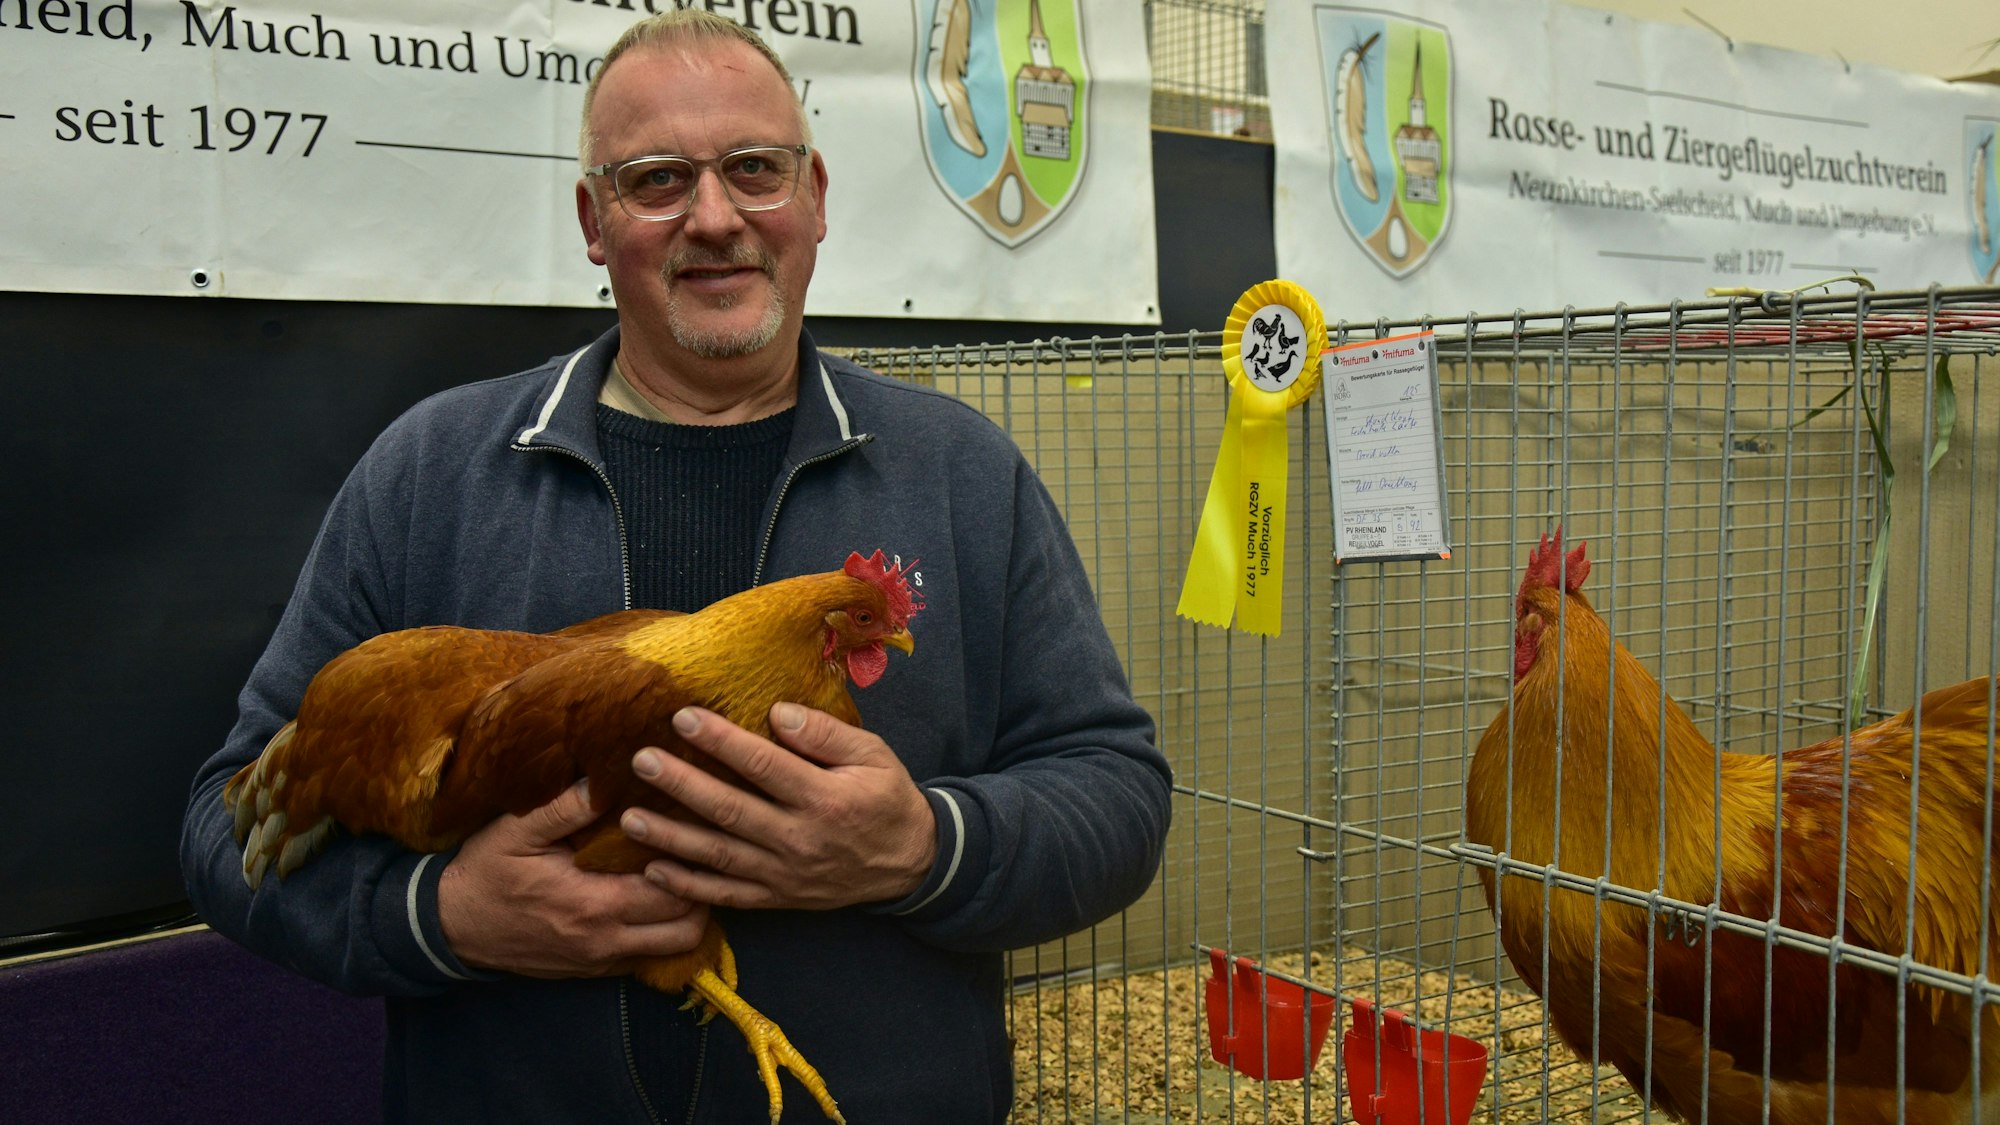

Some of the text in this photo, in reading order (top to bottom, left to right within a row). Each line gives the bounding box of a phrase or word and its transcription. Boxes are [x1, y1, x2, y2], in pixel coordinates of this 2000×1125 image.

[179, 0, 351, 62] Much
[369, 31, 479, 74] und
[55, 99, 328, 158] seit 1977
[1488, 97, 1948, 196] Rasse- und Ziergeflügelzuchtverein
[1712, 249, 1785, 276] seit 1977
[1343, 356, 1370, 367] mifuma
[1385, 348, 1415, 360] mifuma
[1350, 371, 1386, 382] Bewertungskarte
[1394, 364, 1425, 376] Rassegeflügel
[1246, 482, 1260, 597] RGZV Much 1977
[1259, 506, 1273, 576] Vorzüglich
[1354, 526, 1387, 534] RHEINLAND
[914, 571, 923, 587] S
